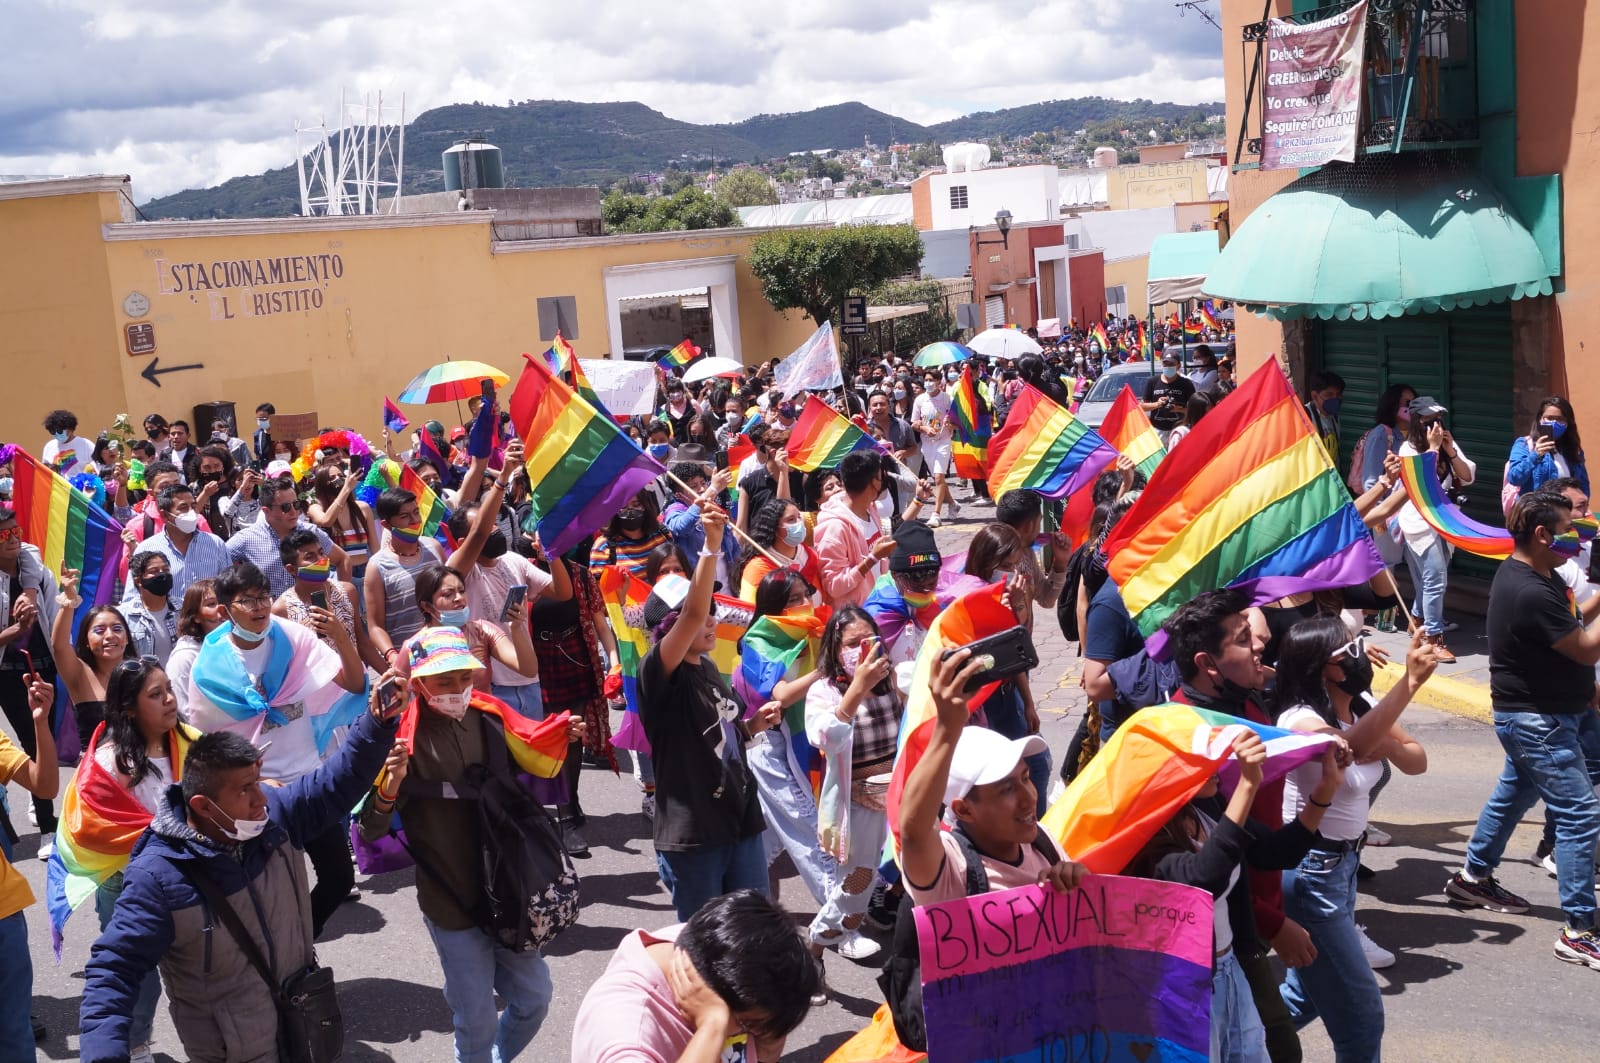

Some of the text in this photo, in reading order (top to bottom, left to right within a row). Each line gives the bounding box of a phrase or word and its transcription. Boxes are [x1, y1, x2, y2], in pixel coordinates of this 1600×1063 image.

[1267, 71, 1299, 86] CREER
[1301, 71, 1312, 83] en
[1266, 93, 1331, 110] Yo creo que
[1264, 114, 1308, 136] Seguiré
[156, 253, 344, 295] ESTACIONAMIENTO
[208, 289, 235, 321] EL
[843, 298, 863, 323] E
[926, 886, 1197, 970] BISEXUAL porque
[936, 969, 966, 998] mi
[1033, 1024, 1111, 1063] TODO
